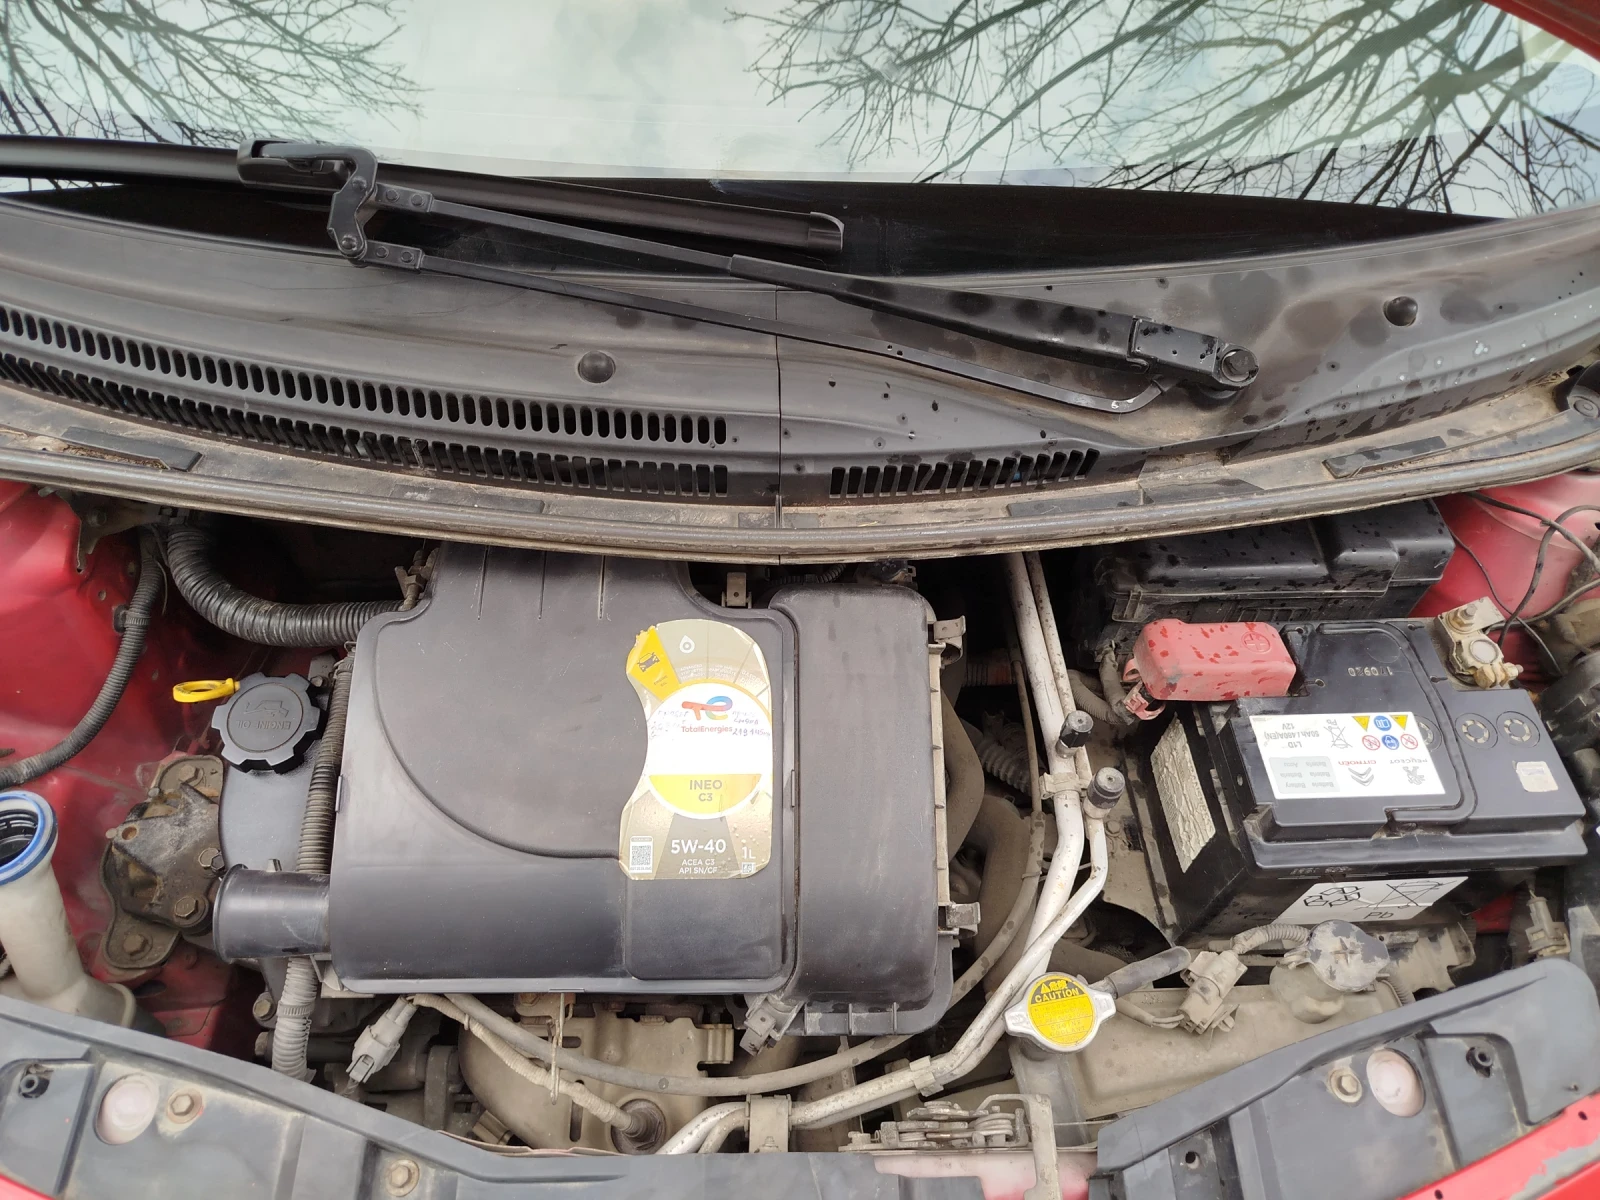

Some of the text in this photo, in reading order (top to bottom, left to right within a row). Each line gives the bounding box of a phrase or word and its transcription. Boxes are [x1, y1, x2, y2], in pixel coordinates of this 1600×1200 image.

[681, 725, 733, 734] TotalEnergies
[1288, 741, 1302, 749] L1D
[689, 780, 723, 791] INEO
[698, 792, 713, 802] C3
[670, 838, 727, 855] 5W-40
[681, 858, 715, 866] ACEA C3
[679, 866, 718, 875] API SN/CF
[1363, 911, 1394, 920] Pb
[1034, 988, 1079, 1003] CAUTION
